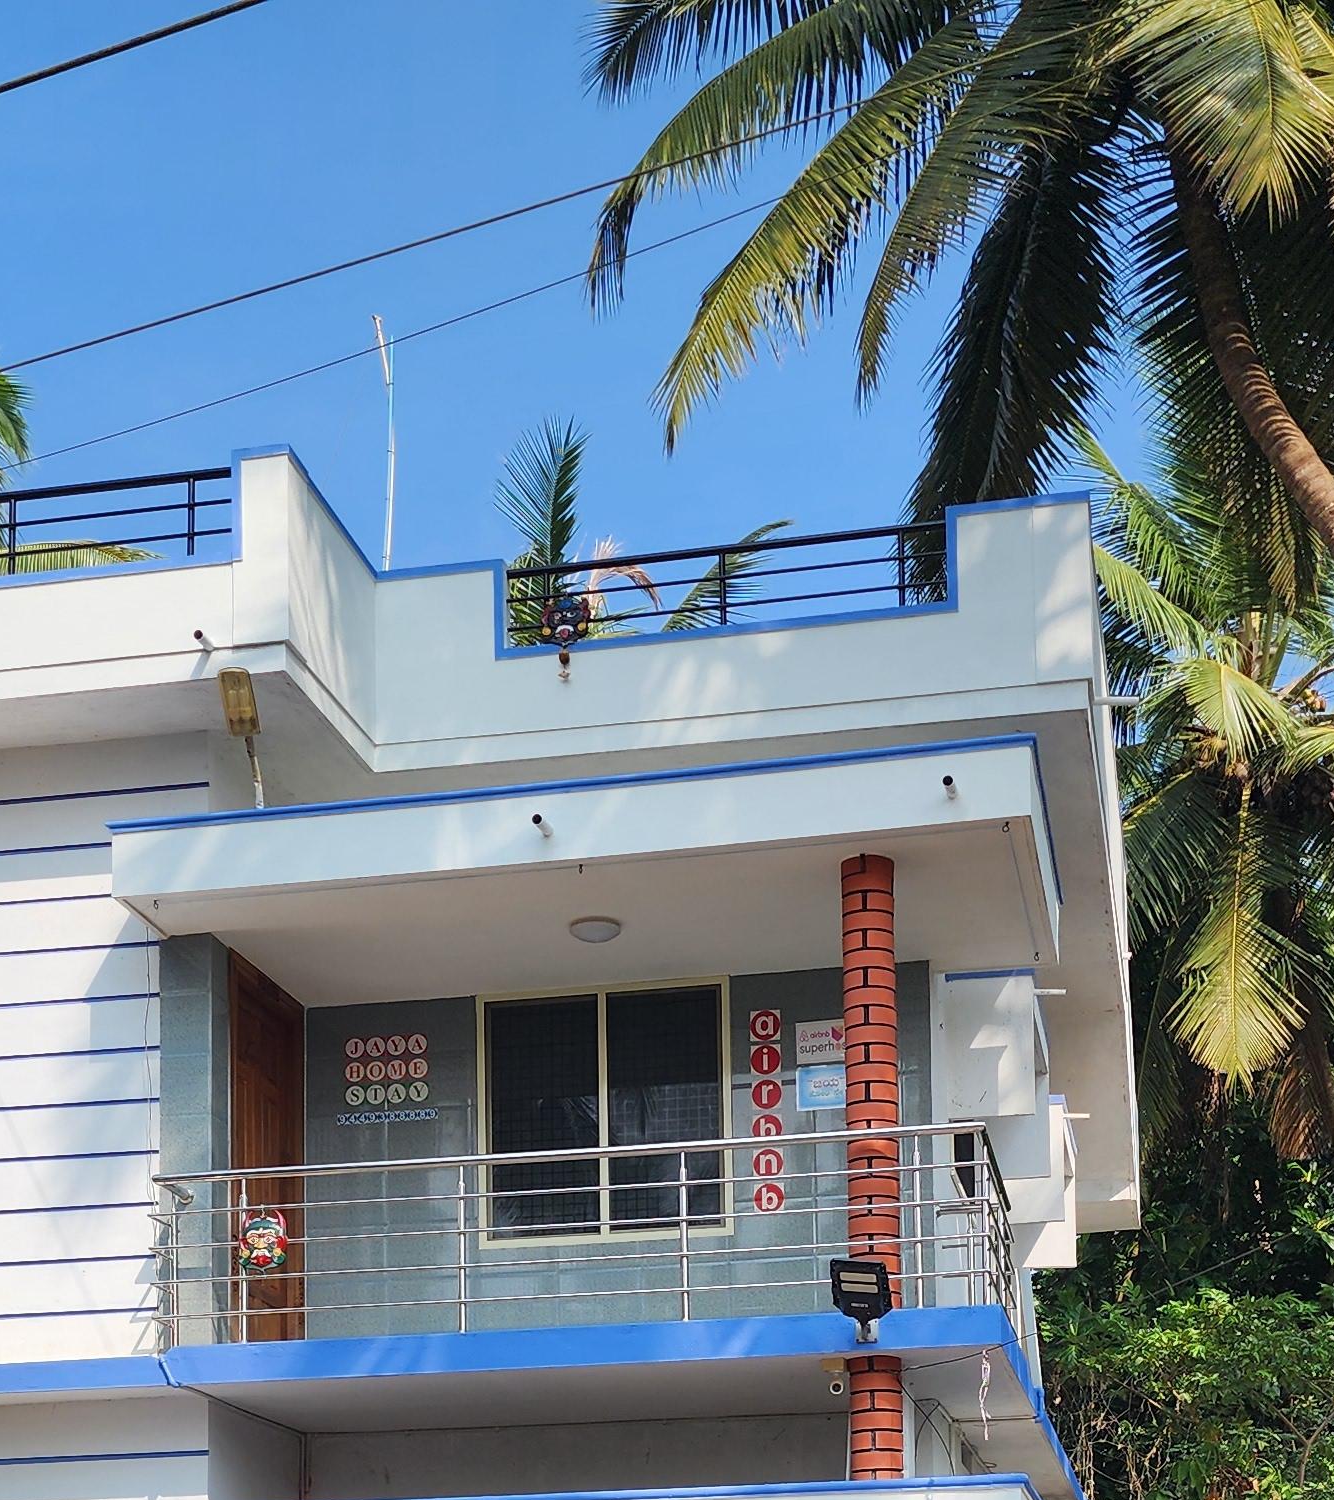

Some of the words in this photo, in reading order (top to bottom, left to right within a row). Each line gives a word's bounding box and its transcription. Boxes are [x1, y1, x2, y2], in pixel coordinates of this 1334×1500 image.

[810, 1030, 830, 1039] airbnb
[349, 1037, 424, 1055] JAYA
[348, 1061, 424, 1079] HOME
[349, 1084, 425, 1103] STAY
[338, 1110, 437, 1125] 9449388889
